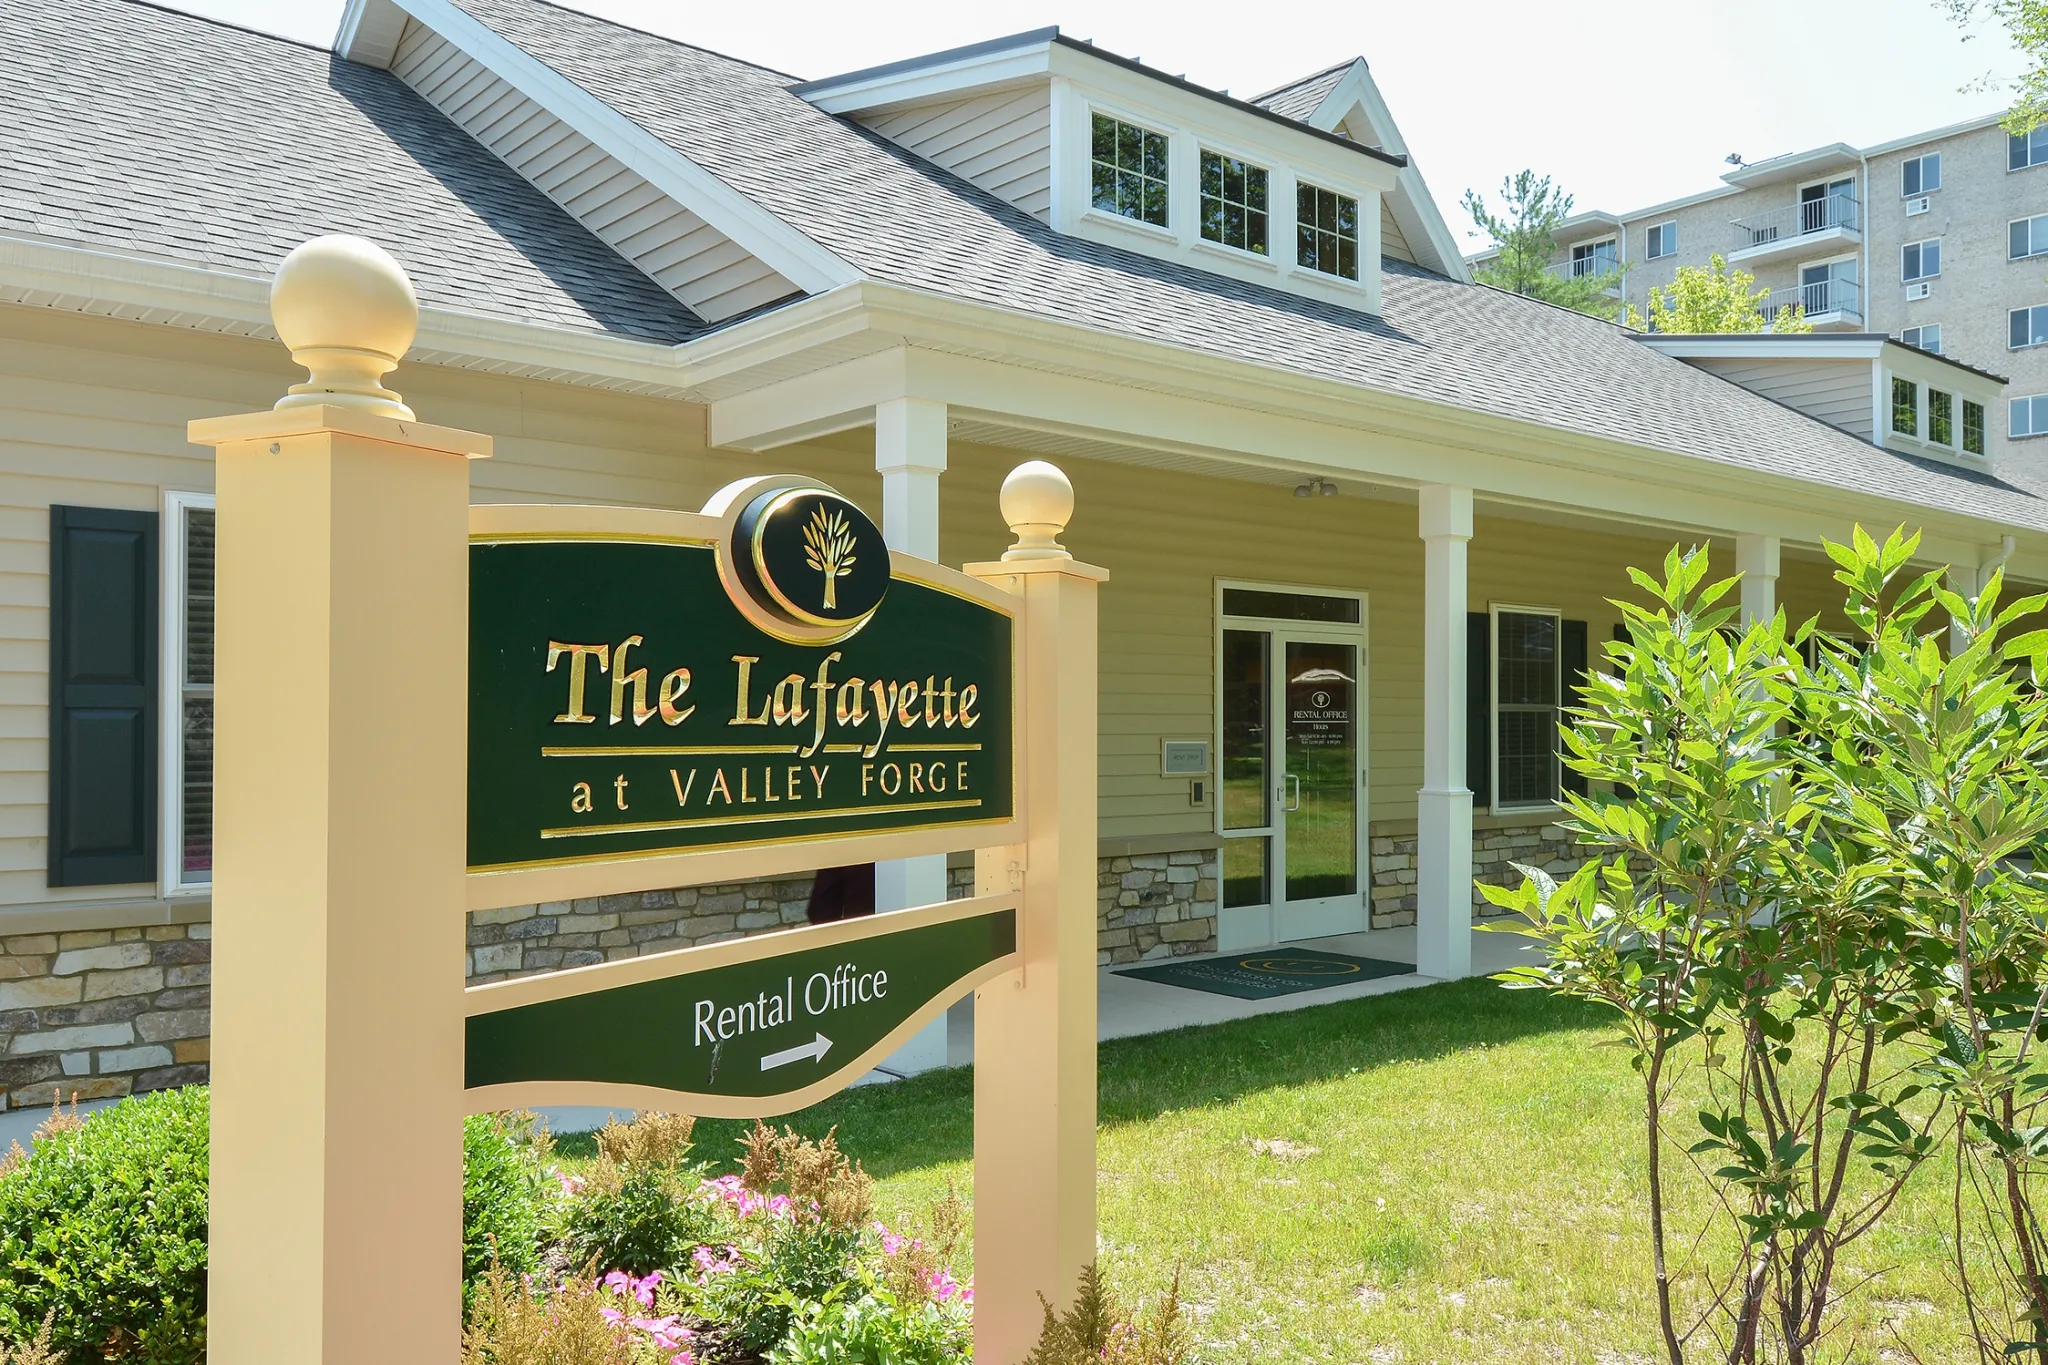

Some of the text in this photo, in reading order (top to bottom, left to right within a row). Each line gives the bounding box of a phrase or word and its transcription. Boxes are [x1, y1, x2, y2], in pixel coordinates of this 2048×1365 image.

[546, 635, 981, 758] The Lafayette
[1293, 710, 1348, 719] RENTAL OFFICE
[570, 761, 969, 814] at VALLEY FORGE
[694, 963, 889, 1046] Rental Office
